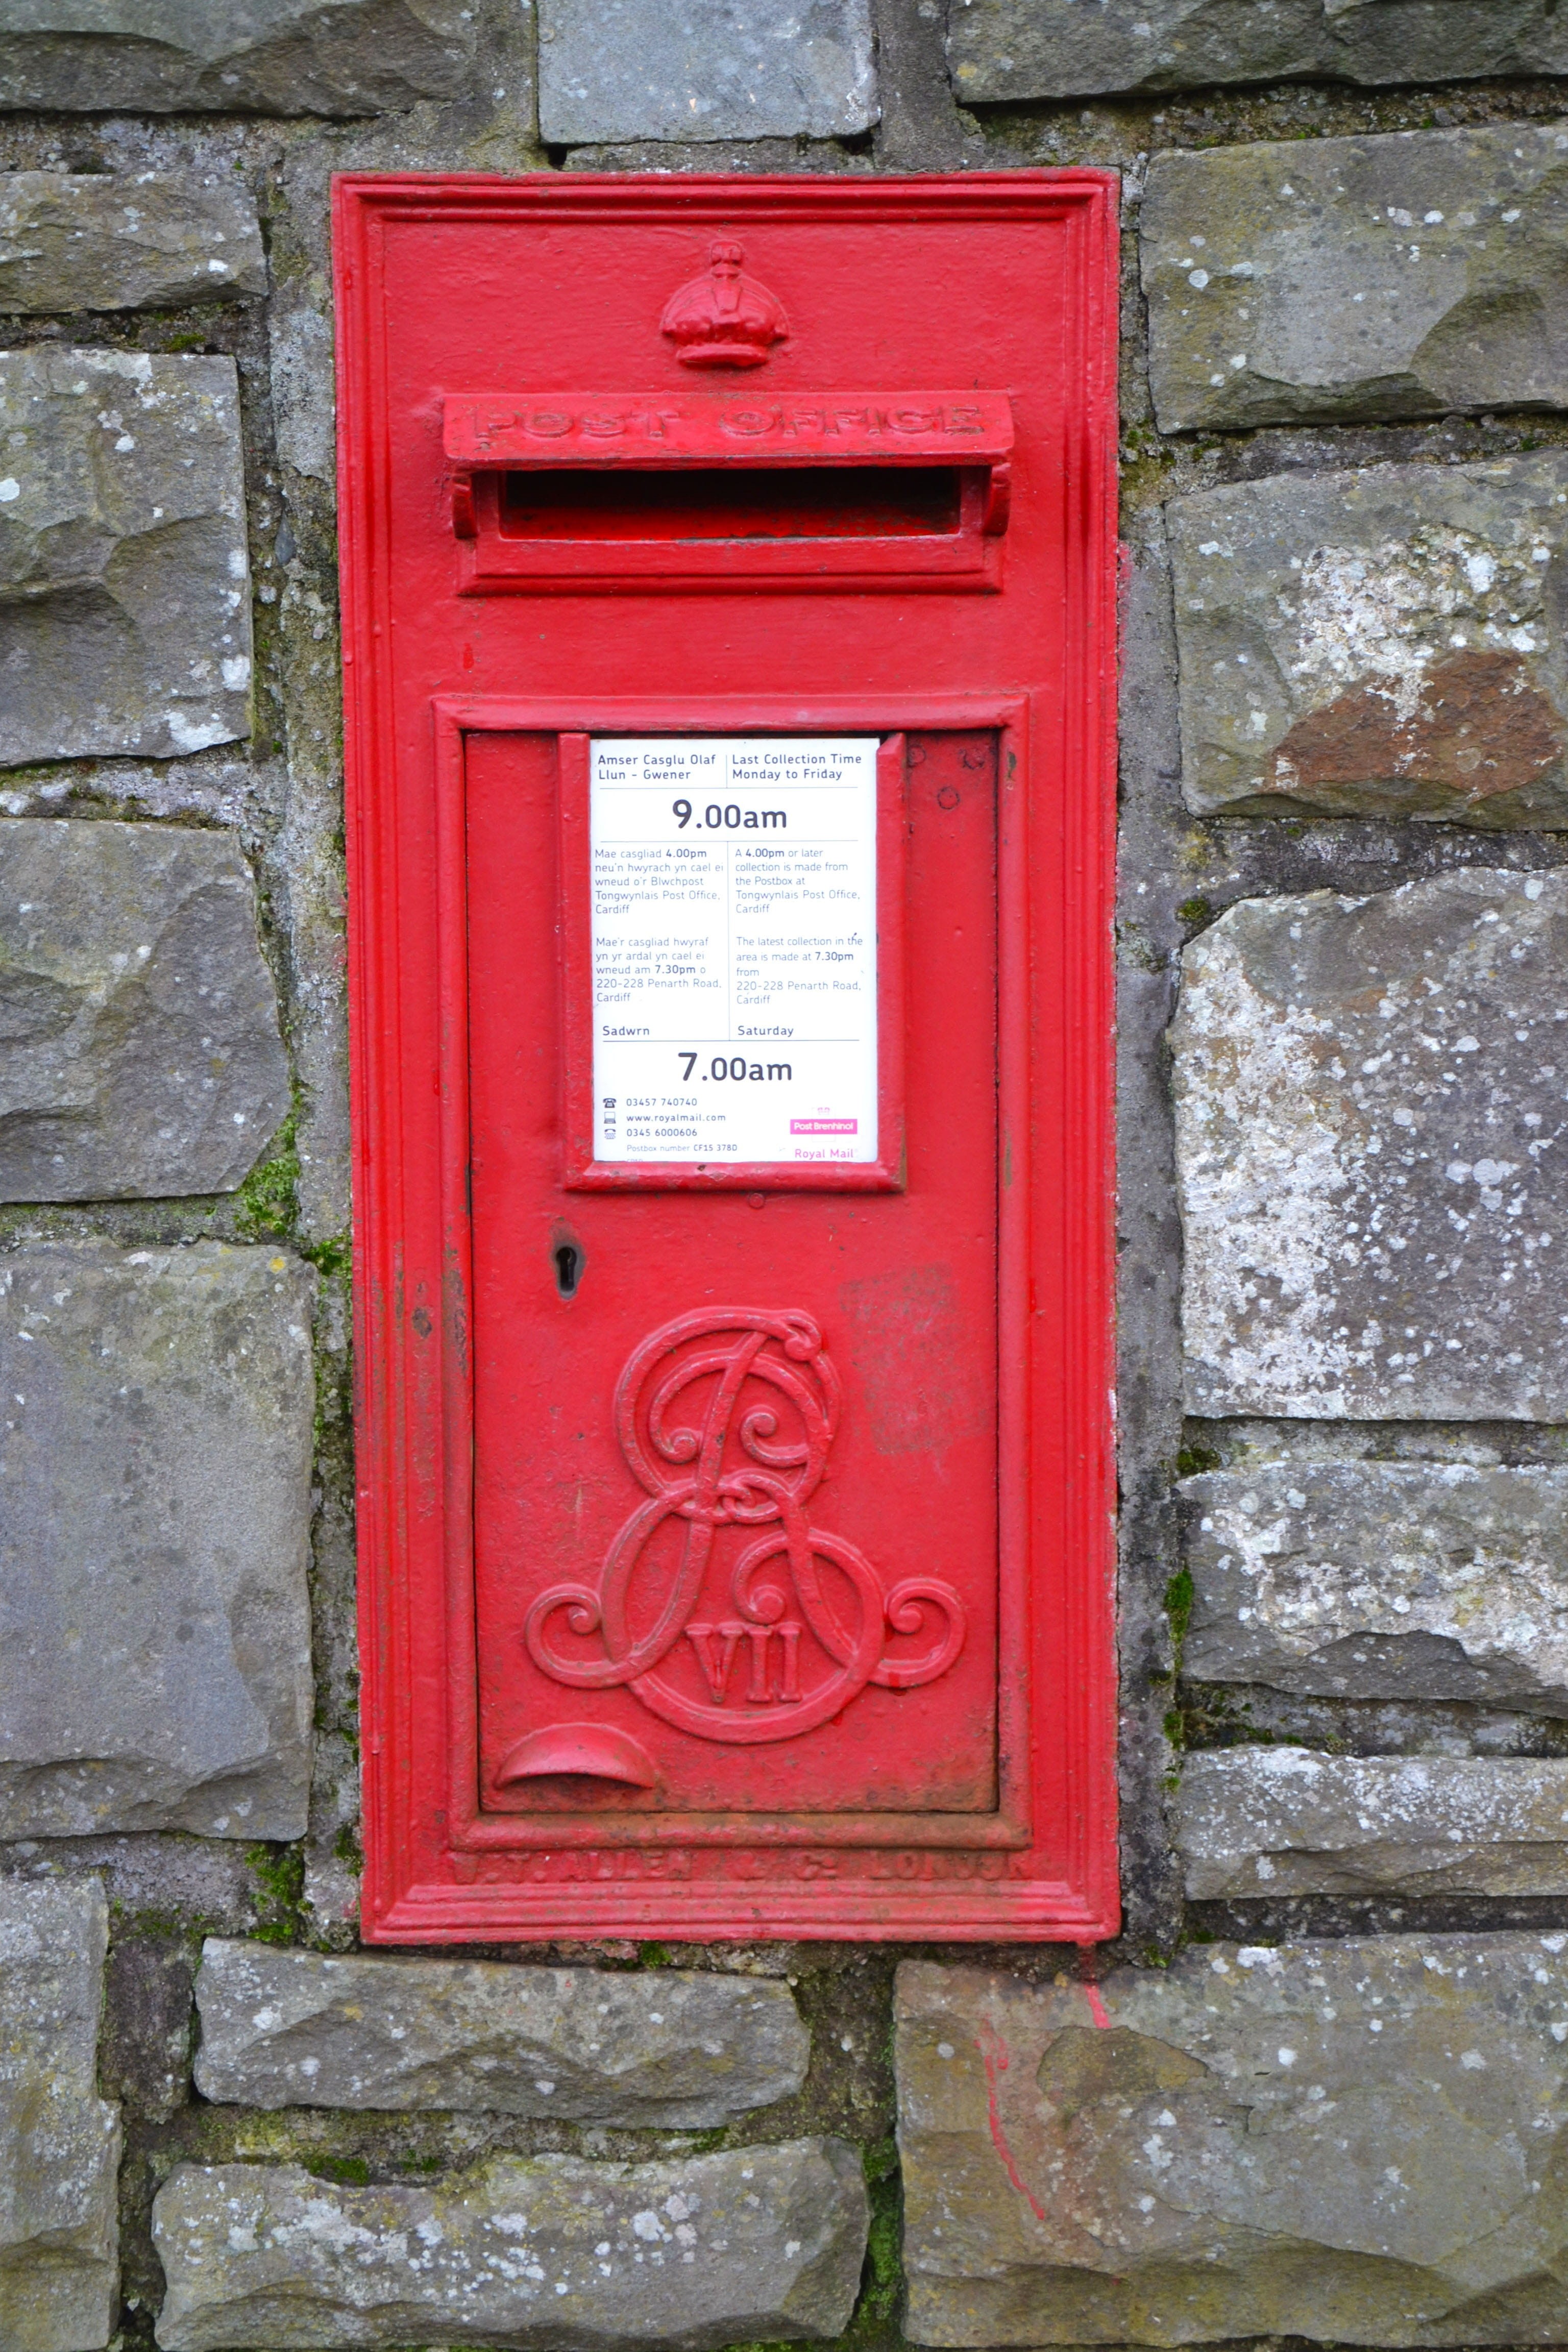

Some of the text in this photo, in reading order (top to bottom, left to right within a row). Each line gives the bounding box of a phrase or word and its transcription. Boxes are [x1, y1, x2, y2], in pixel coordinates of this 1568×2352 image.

[475, 406, 985, 438] POST OFFICE
[598, 754, 716, 767] Amser Casglu Olaf
[732, 753, 861, 764] Last Collection Time
[599, 769, 625, 779] Llun
[644, 769, 691, 779] Gwener
[733, 769, 842, 781] Monday to Friday
[672, 799, 787, 829] 9.00am
[595, 848, 706, 860] Mae casgliad 4.00pm
[735, 849, 742, 857] A
[746, 848, 784, 859] 4.00pm
[595, 863, 723, 873] neu'n hwyrach yn cael ei
[736, 862, 848, 871] collection is made from
[595, 877, 703, 887] wneud o'r Blwchpost
[736, 877, 751, 885] the
[755, 876, 792, 885] Postbox
[595, 890, 720, 902] Tongwynlais Post Office,
[736, 890, 860, 901] Tongwynlais Post Office,
[596, 904, 629, 914] Cardiff
[737, 904, 769, 913] Cardiff
[597, 937, 708, 948] Mae'r casgliad hwyraf
[737, 937, 754, 945] The
[758, 937, 783, 945] latest
[788, 937, 831, 945] collection
[848, 936, 863, 945] the
[596, 953, 608, 962] yn
[612, 953, 622, 962] yr
[626, 951, 651, 960] ardal
[656, 953, 667, 962] yn
[672, 951, 691, 960] cael
[815, 951, 853, 962] 7.30pm
[596, 966, 630, 974] wneud
[655, 965, 695, 975] 7.30pm
[737, 968, 759, 976] from
[597, 978, 721, 988] 220-228 Penarth Road,
[737, 981, 861, 990] 220-228 Penarth Road,
[597, 993, 630, 1001] Cardiff
[737, 995, 770, 1004] Cardiff
[603, 1025, 649, 1036] Sadwrn
[738, 1025, 794, 1037] Saturday
[678, 1052, 792, 1081] 7.00am
[626, 1114, 725, 1123] www.royalmail.com
[795, 1149, 853, 1160] Royal Mail
[686, 1622, 802, 1702] VII
